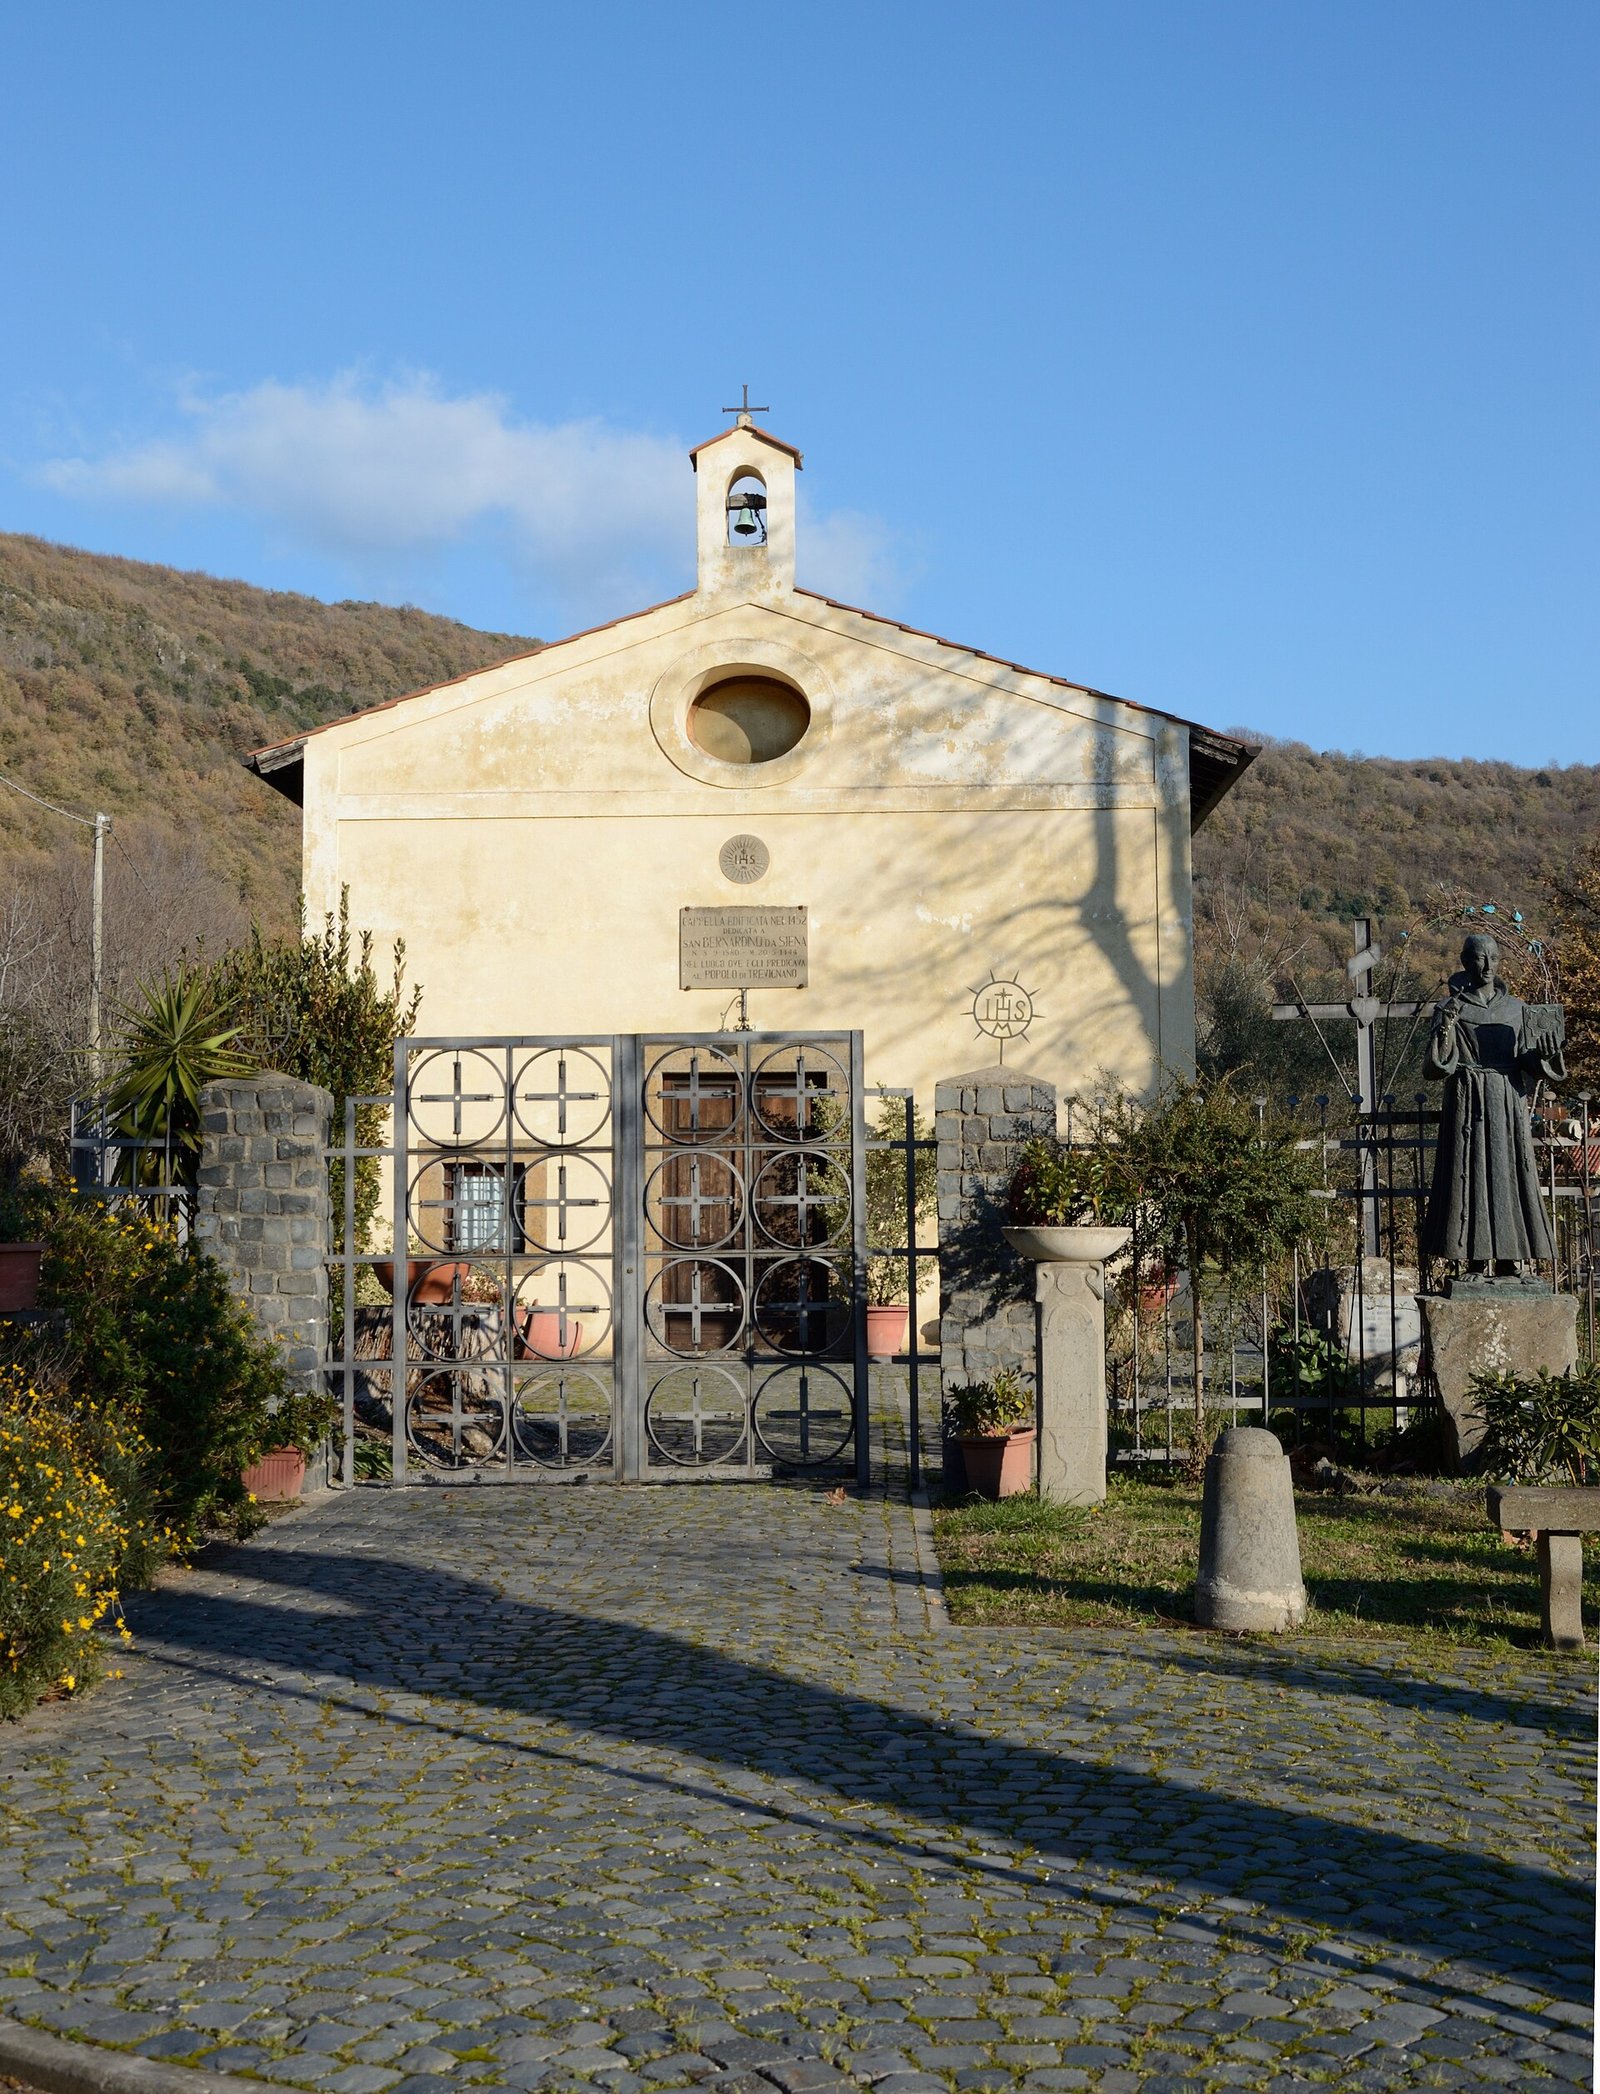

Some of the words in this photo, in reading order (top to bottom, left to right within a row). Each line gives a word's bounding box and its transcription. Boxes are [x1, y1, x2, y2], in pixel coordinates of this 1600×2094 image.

[735, 854, 755, 865] IHS
[683, 940, 701, 948] SAN
[778, 935, 807, 947] SIENA
[727, 959, 742, 968] OVE
[704, 969, 738, 980] POPOLO
[985, 998, 1026, 1021] IHS
